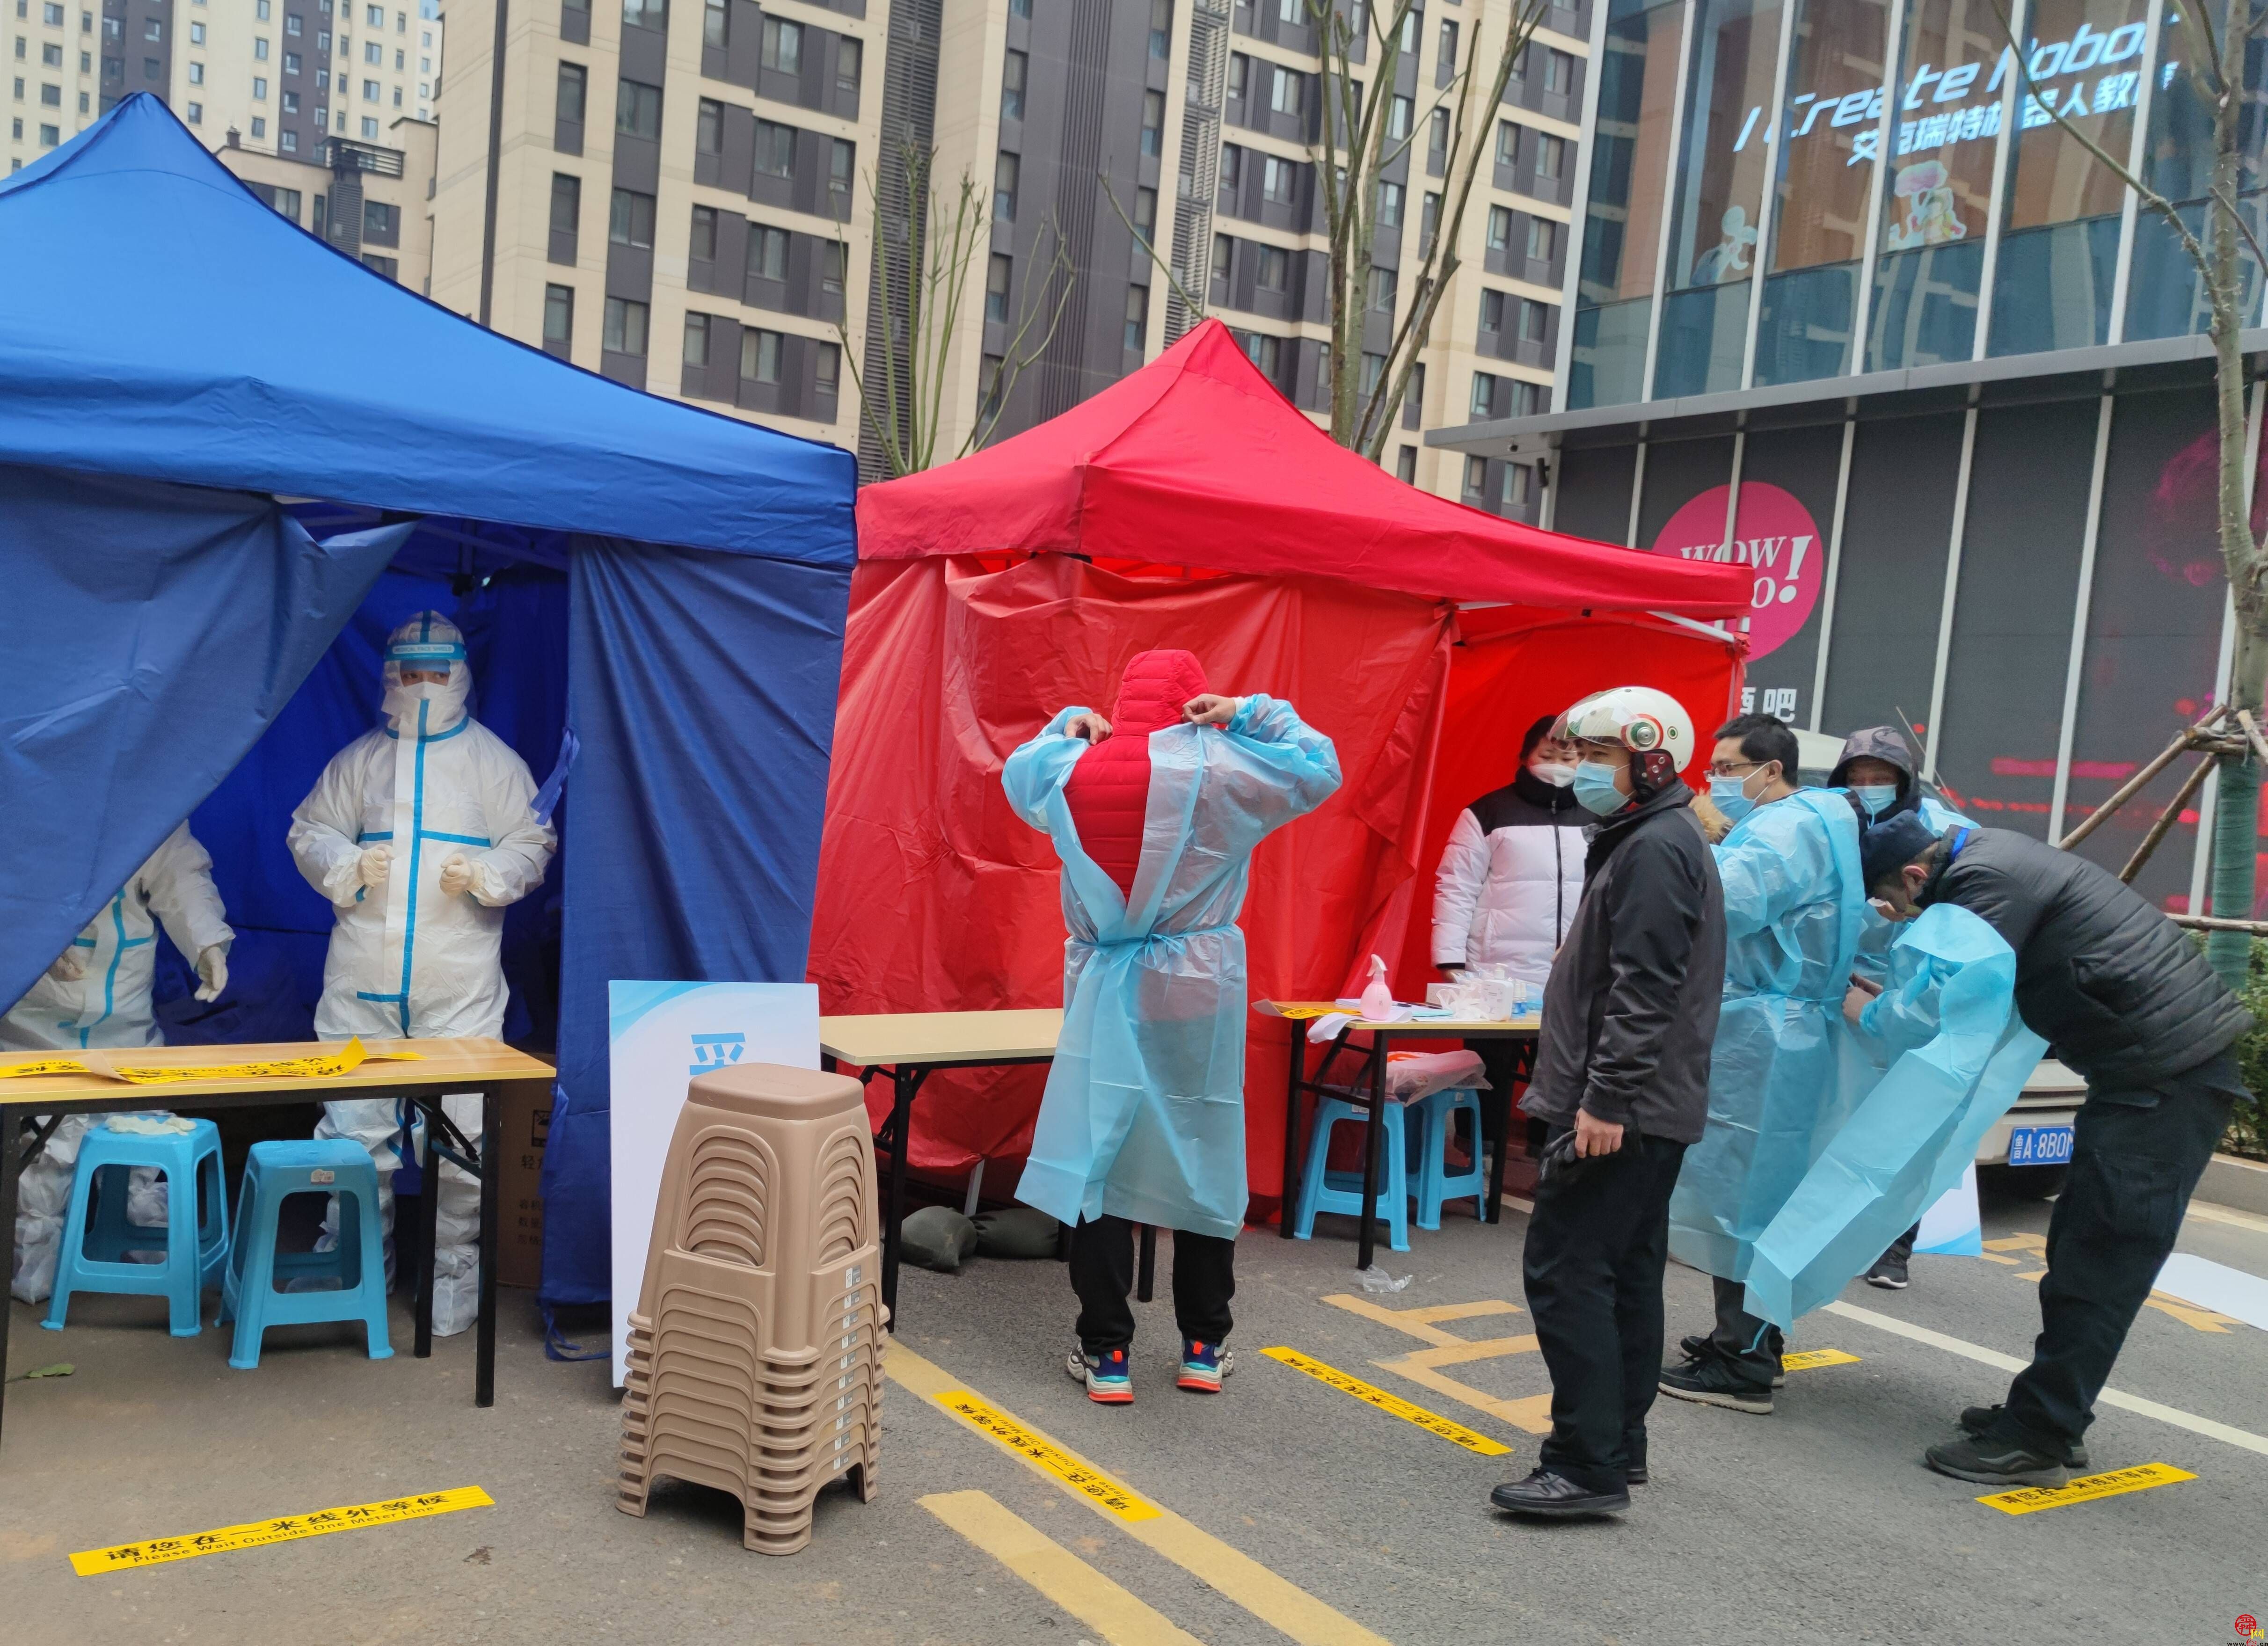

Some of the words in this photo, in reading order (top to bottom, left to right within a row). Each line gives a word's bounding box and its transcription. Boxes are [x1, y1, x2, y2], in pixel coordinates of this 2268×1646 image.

[1985, 13, 2180, 93] obo
[980, 1408, 999, 1419] Line
[1283, 1358, 1480, 1446] 请您在一米线外等候
[955, 1404, 1131, 1510] 请您在一米线外等候
[1023, 1434, 1041, 1445] One
[1041, 1446, 1075, 1467] Outside
[1074, 1467, 1098, 1481] Wait
[1098, 1481, 1130, 1500] Please
[104, 1495, 450, 1560] 请您在一米线外等候
[134, 1548, 190, 1563] Please
[197, 1541, 236, 1551] Wait
[243, 1529, 307, 1544] Outside
[314, 1521, 345, 1531] One
[351, 1513, 396, 1525] Meter
[402, 1506, 434, 1515] Line
